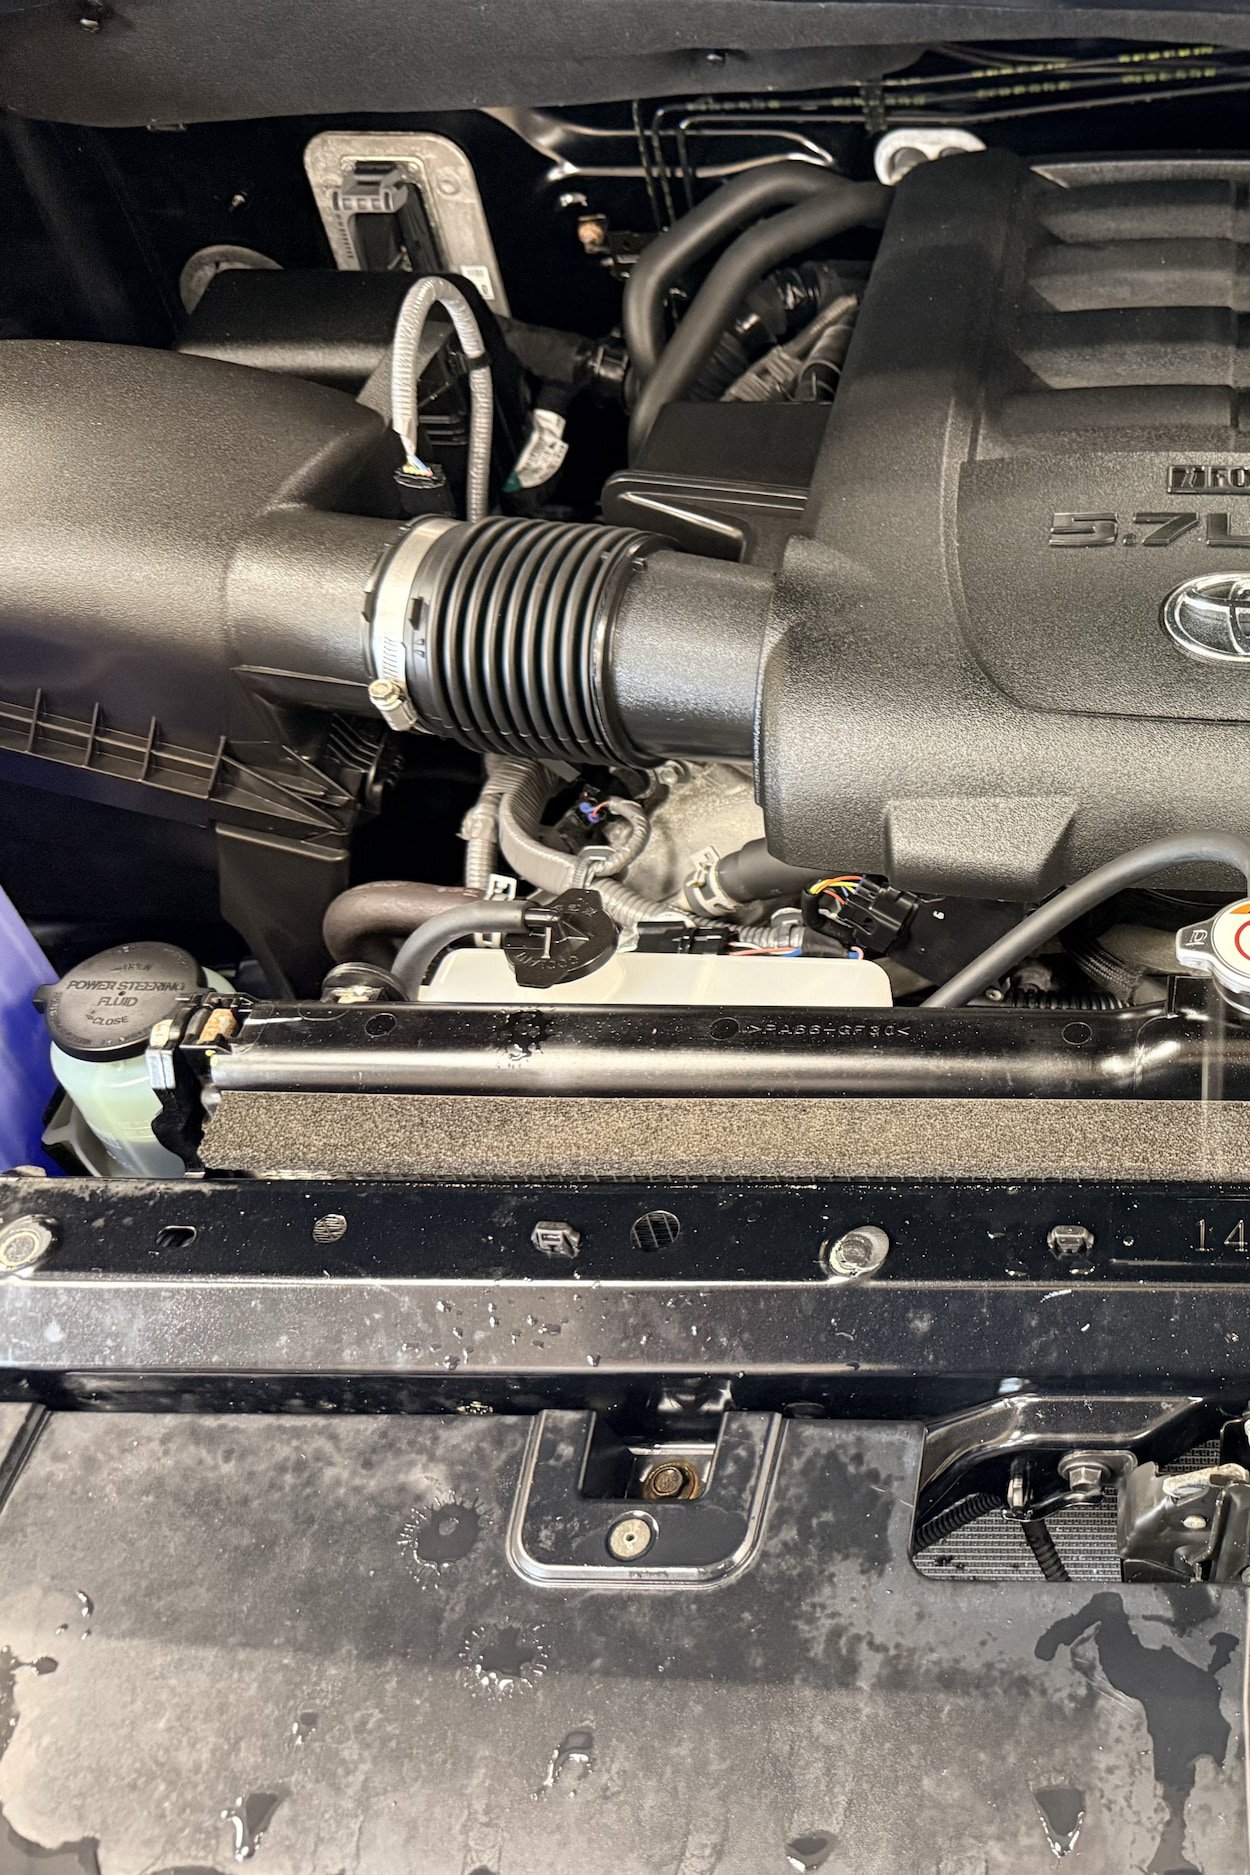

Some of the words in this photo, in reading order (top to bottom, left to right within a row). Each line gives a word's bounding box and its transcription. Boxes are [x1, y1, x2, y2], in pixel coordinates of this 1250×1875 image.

[66, 980, 116, 991] POWER
[117, 981, 186, 991] STEERING
[97, 996, 138, 1007] FLUID
[92, 1016, 129, 1026] CLOSE
